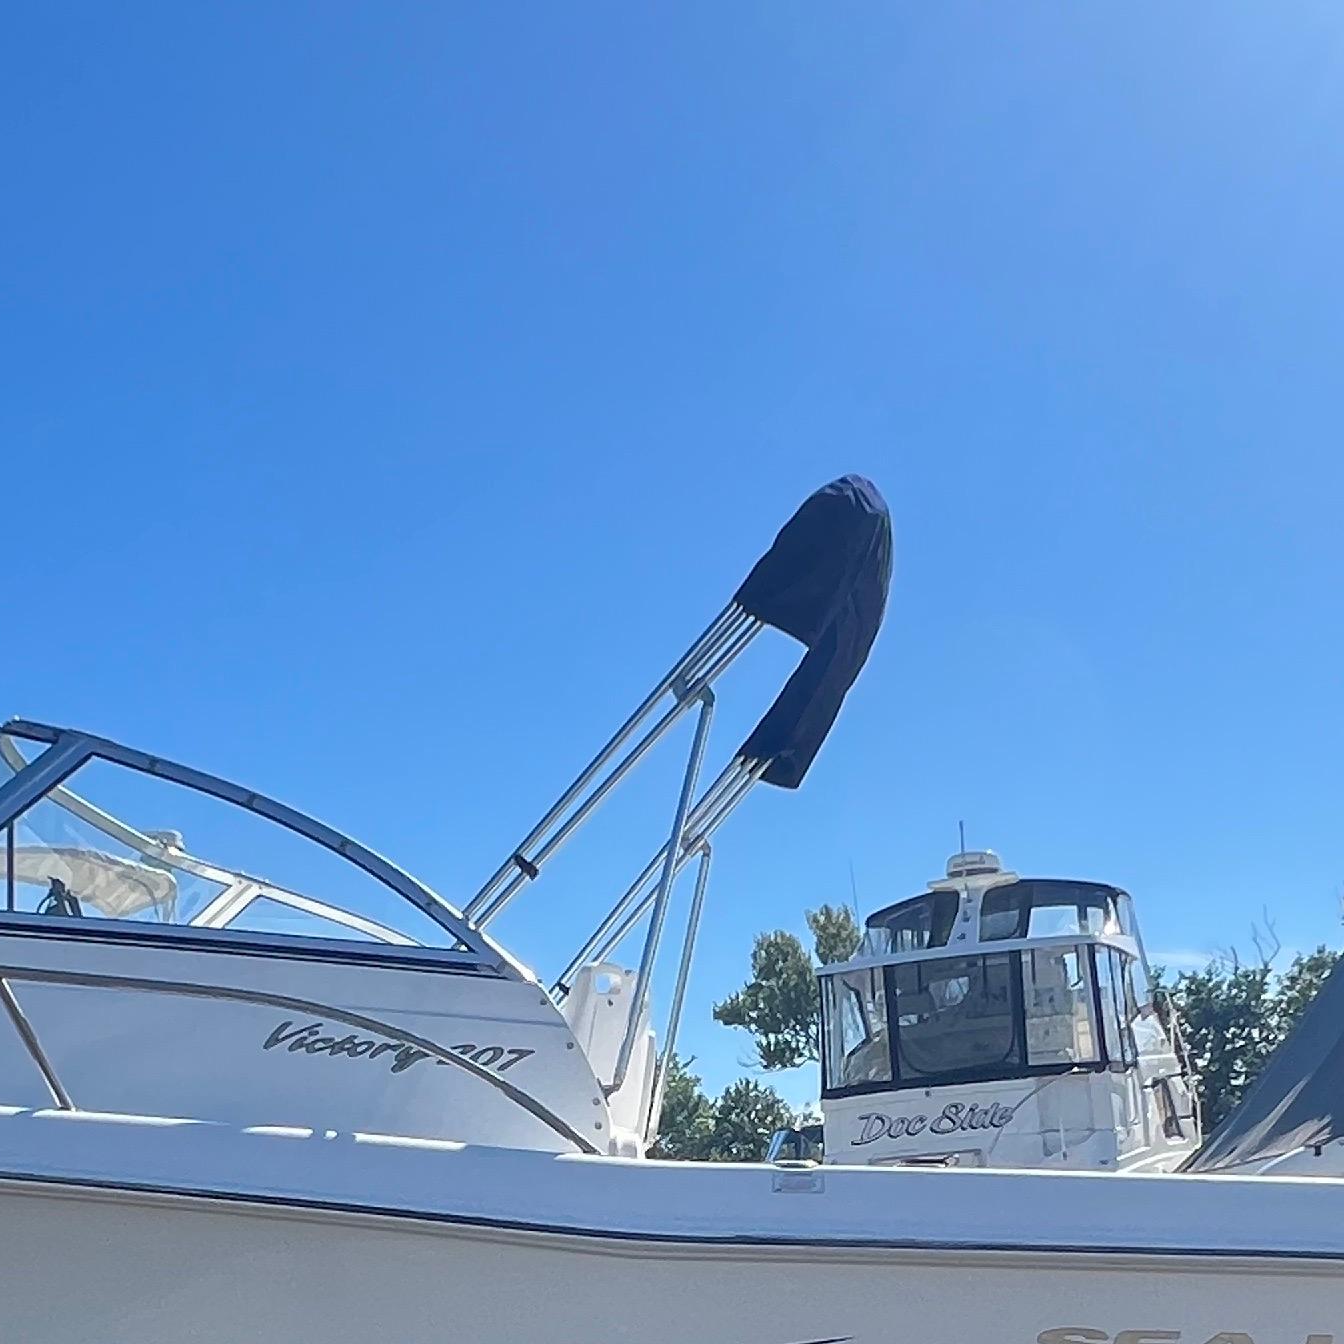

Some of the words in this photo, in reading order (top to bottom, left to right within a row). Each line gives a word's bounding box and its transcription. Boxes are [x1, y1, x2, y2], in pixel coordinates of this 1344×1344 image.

[262, 1020, 432, 1074] Victory
[851, 1112, 928, 1146] Doc
[929, 1102, 1014, 1135] Side
